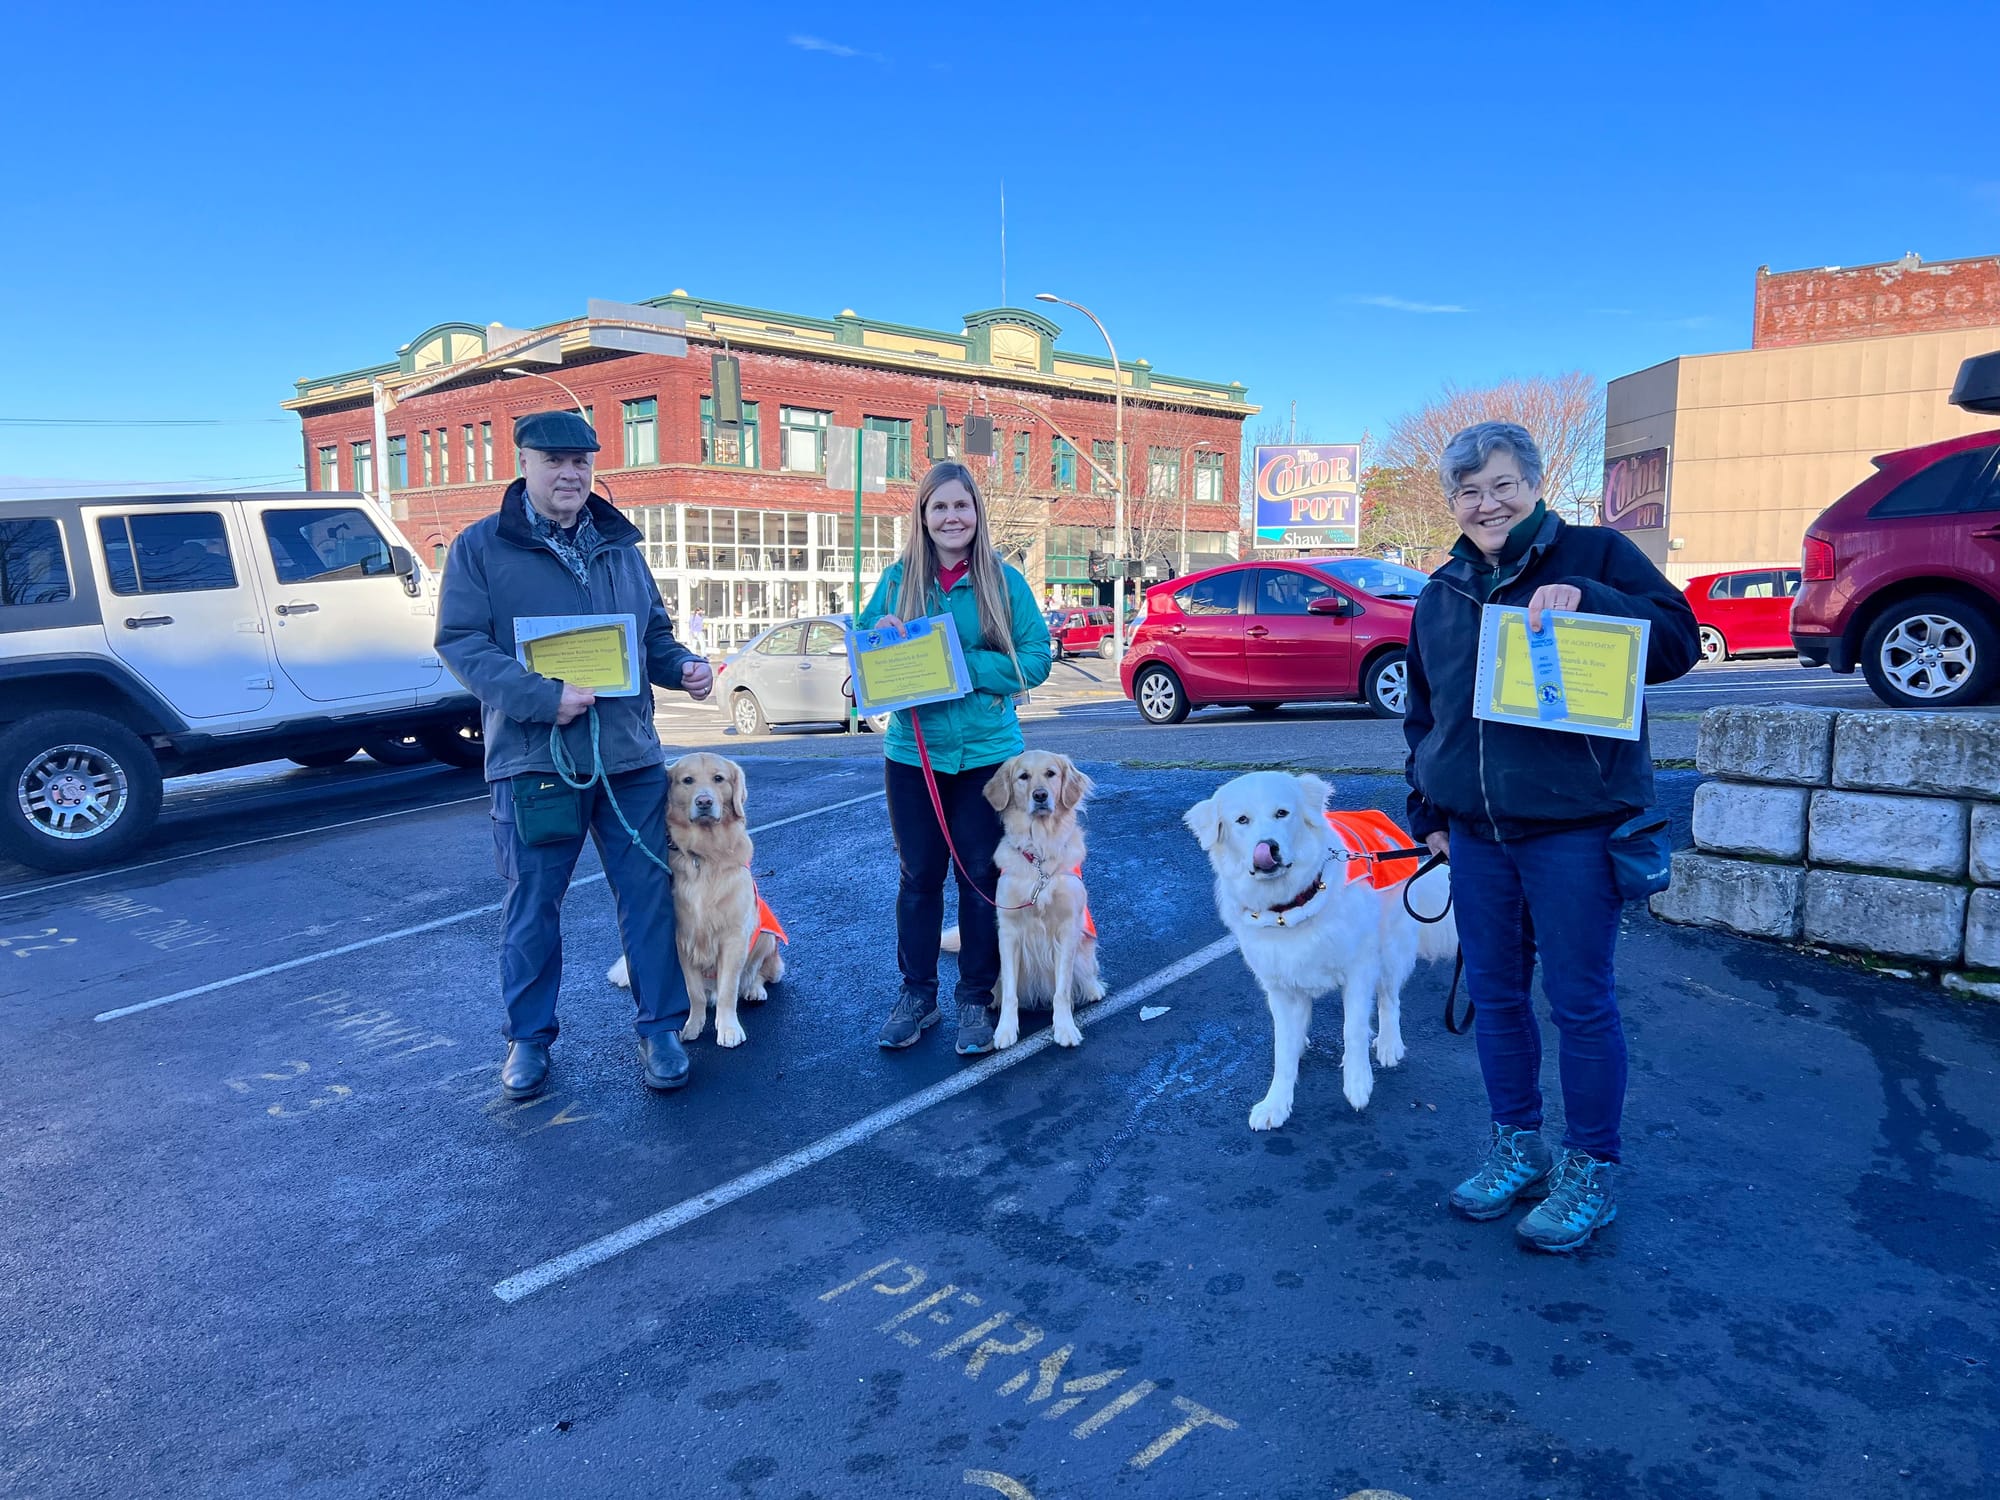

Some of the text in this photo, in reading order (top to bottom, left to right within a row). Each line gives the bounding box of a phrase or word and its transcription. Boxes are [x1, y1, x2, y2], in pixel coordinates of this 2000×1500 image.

[1297, 449, 1319, 464] The
[1258, 454, 1354, 502] COLOR
[1605, 458, 1663, 523] COLOR
[1289, 497, 1349, 522] POT
[1636, 505, 1658, 527] POT
[1283, 532, 1323, 545] Shaw
[817, 1257, 1239, 1470] PERMIT
